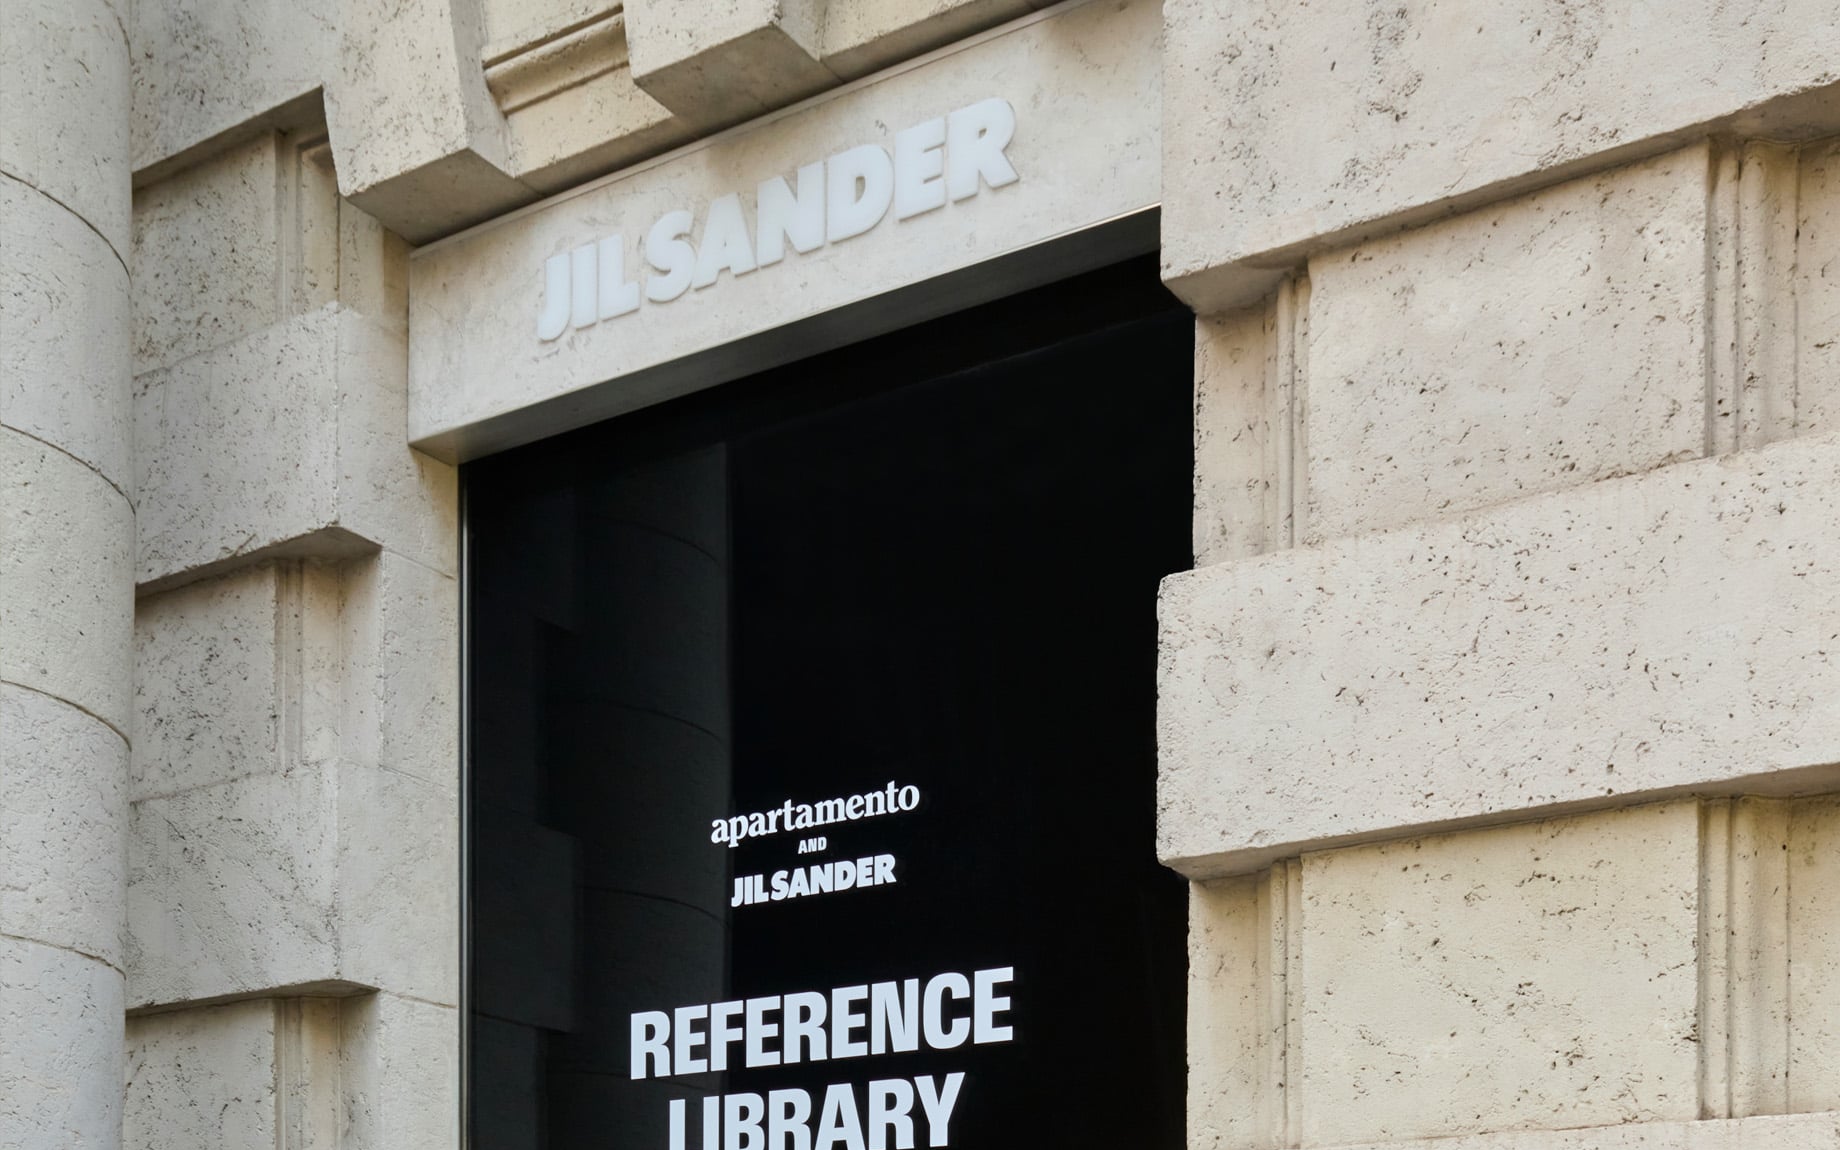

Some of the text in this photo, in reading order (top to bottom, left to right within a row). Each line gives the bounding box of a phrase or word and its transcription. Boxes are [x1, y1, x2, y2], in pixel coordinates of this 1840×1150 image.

[711, 780, 920, 848] apartamento
[797, 836, 828, 854] AND
[630, 966, 1014, 1080] REFERENCE
